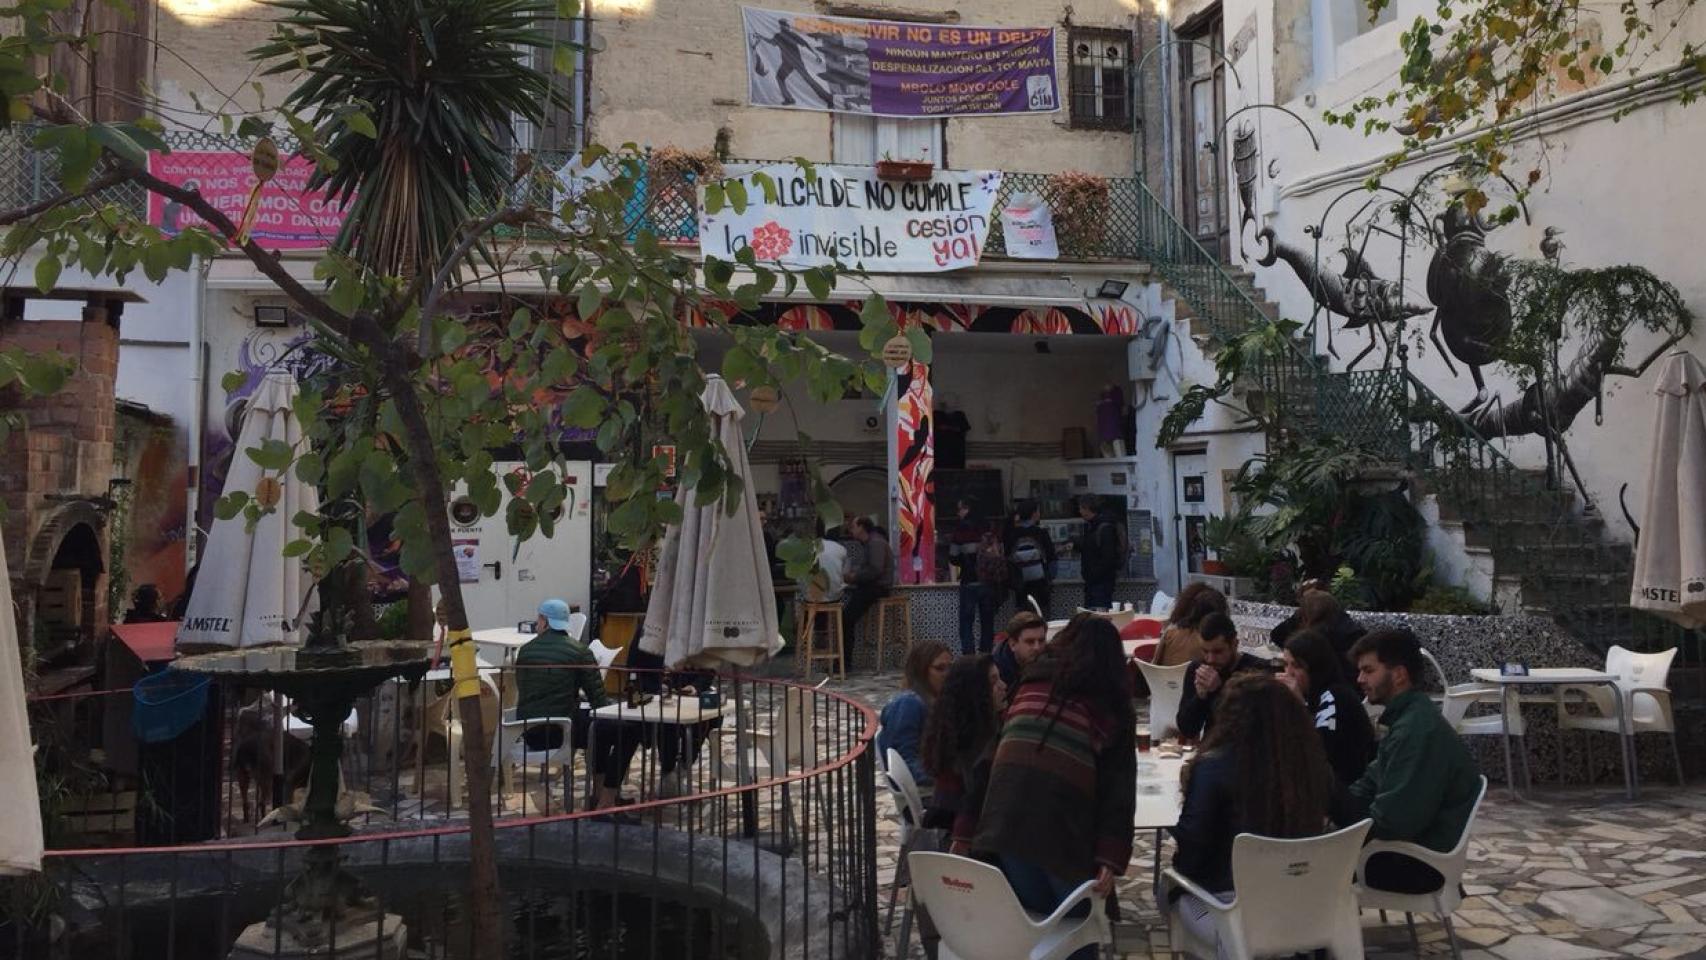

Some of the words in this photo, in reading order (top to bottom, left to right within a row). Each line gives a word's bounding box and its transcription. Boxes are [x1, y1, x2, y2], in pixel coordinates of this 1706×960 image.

[907, 26, 932, 44] NO
[938, 29, 961, 45] ES
[967, 30, 992, 46] UN
[985, 51, 1000, 60] EN
[206, 177, 238, 189] NOS
[865, 179, 896, 211] NO
[901, 181, 975, 212] CUMPLE
[181, 206, 209, 224] UN
[291, 215, 342, 227] DIGNA
[906, 213, 986, 238] cesión
[799, 224, 898, 257] invisible
[932, 233, 978, 266] ya!
[184, 617, 230, 632] AMSTEL
